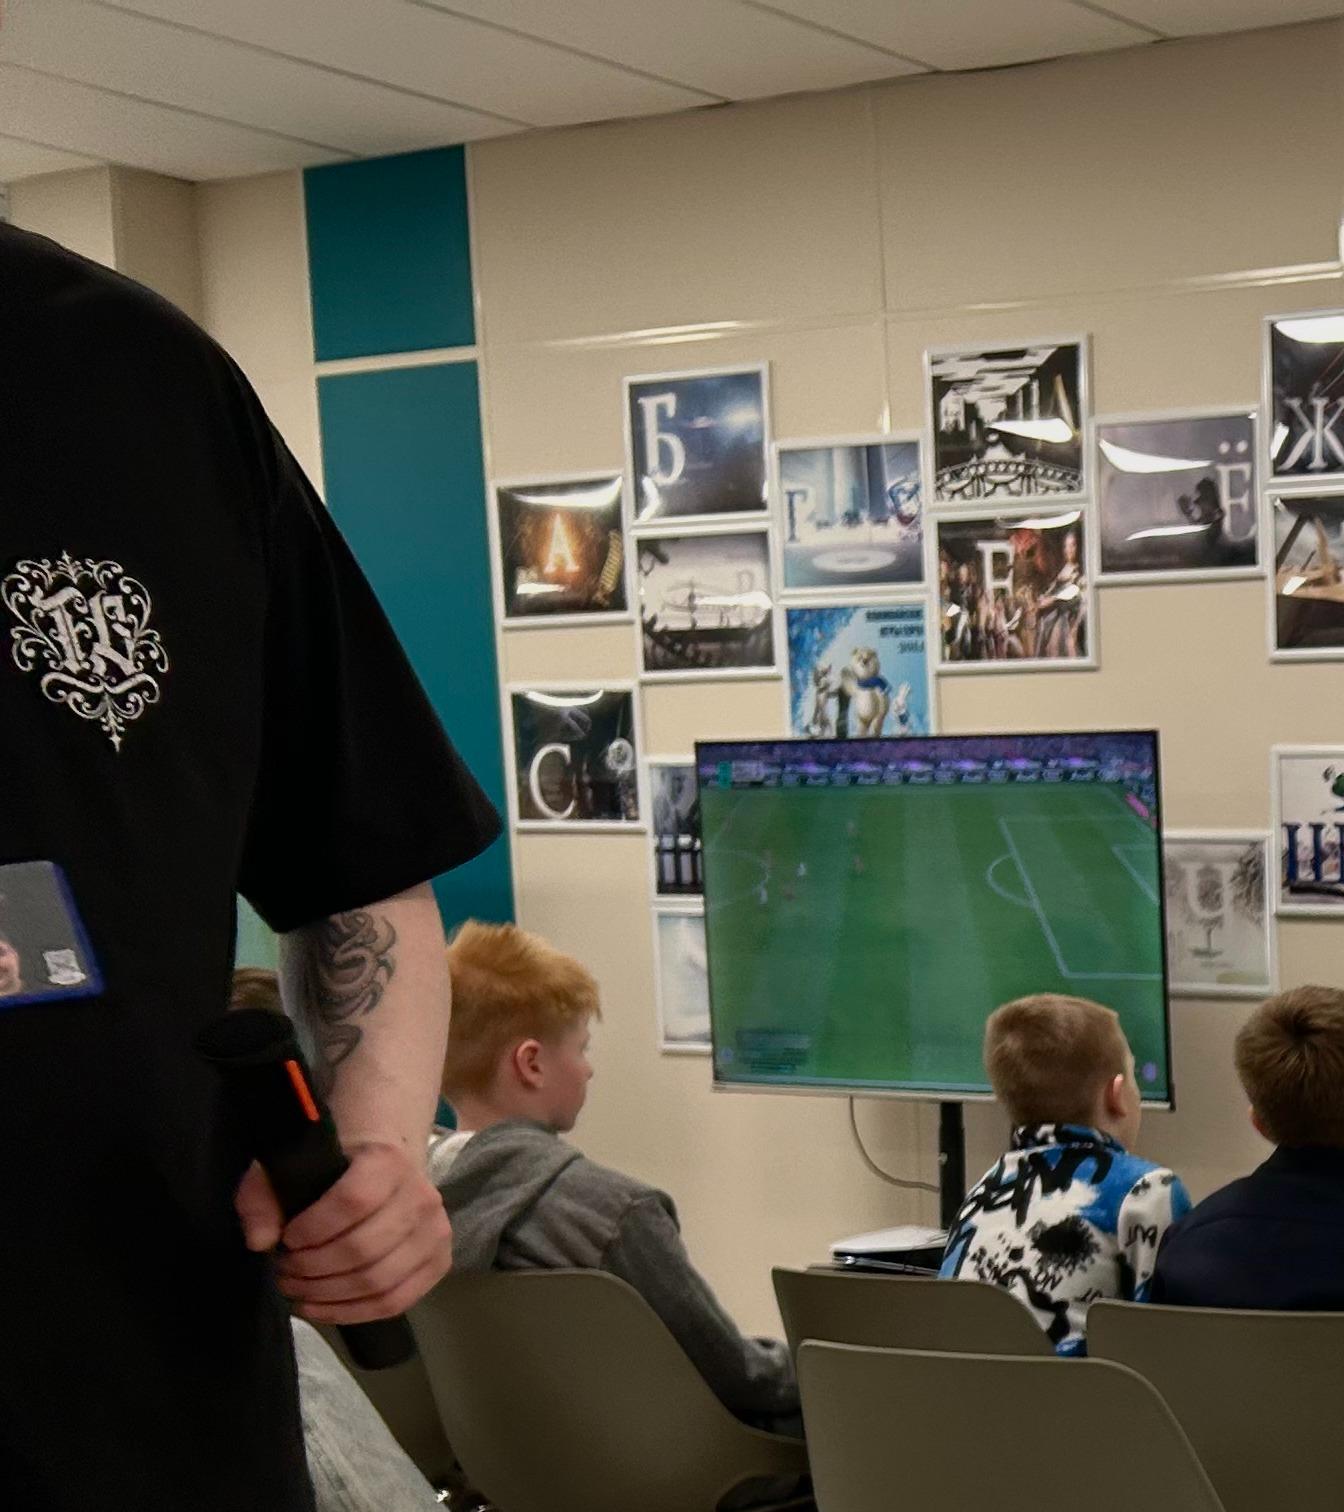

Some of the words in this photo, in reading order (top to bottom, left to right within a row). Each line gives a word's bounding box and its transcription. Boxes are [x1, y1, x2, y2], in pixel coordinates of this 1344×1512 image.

[638, 392, 687, 486] Б
[543, 513, 580, 574] А
[528, 742, 579, 820] С
